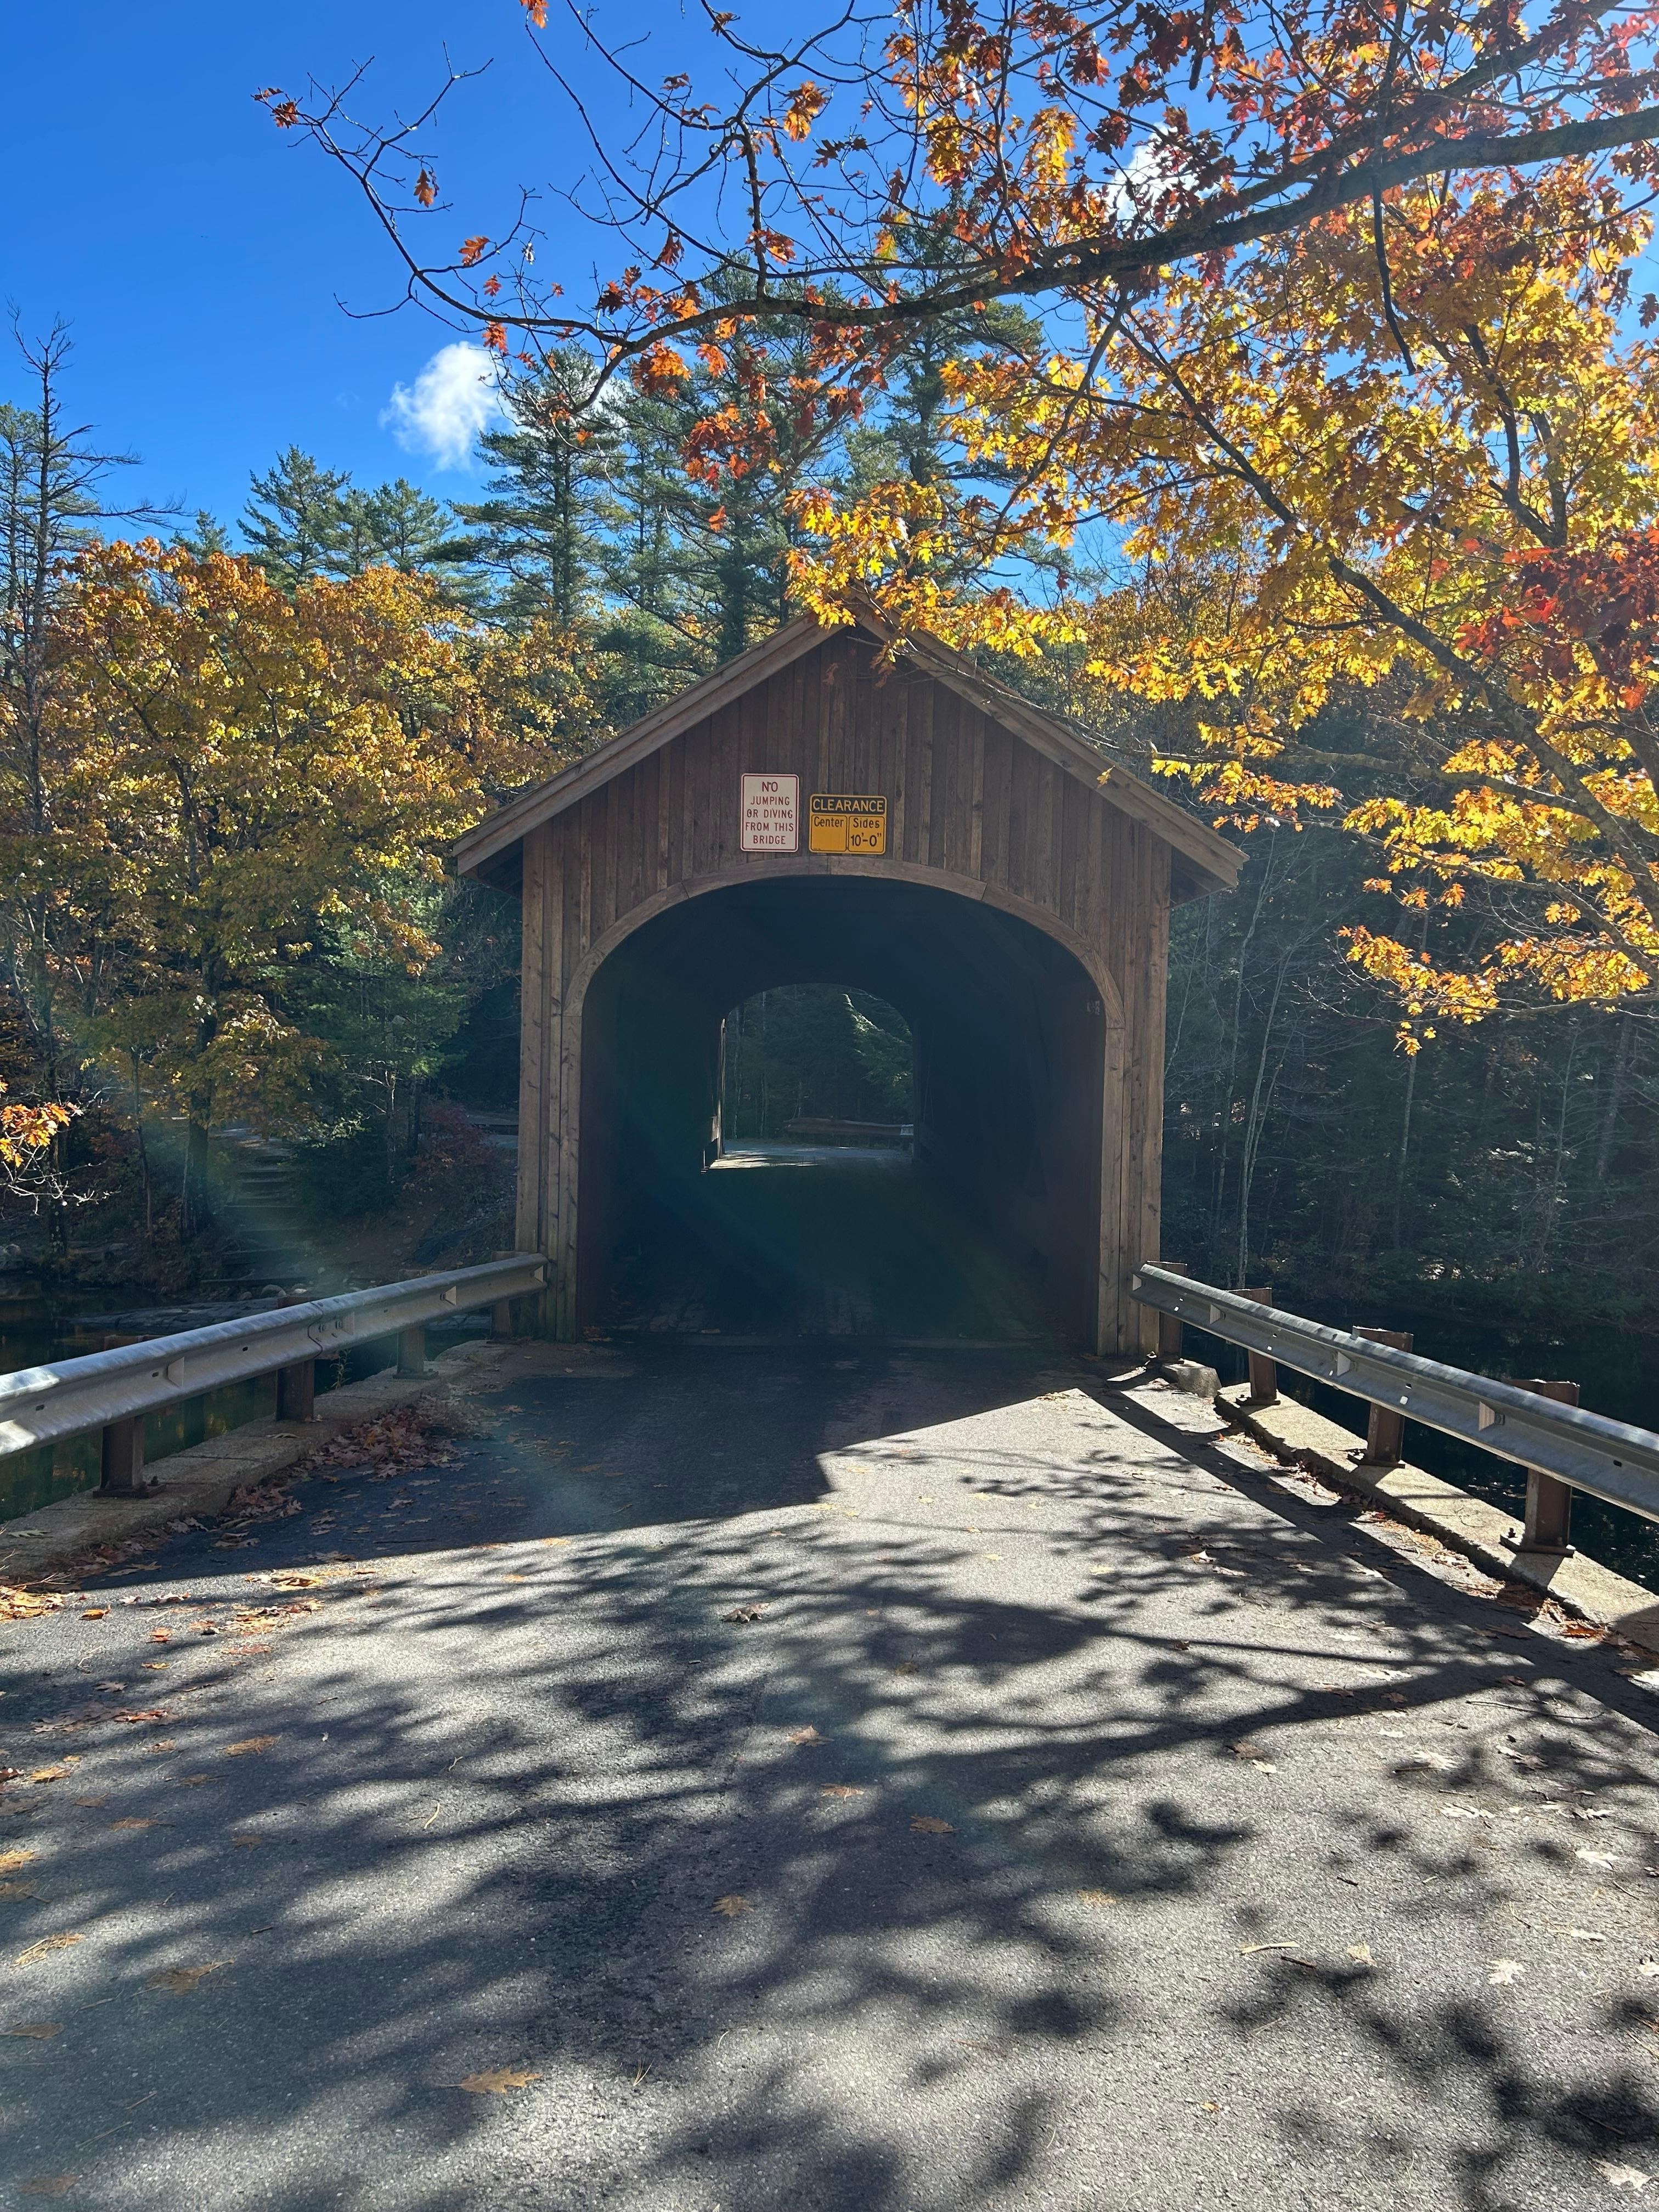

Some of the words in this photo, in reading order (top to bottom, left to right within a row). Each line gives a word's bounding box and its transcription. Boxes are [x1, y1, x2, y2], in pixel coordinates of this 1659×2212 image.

[762, 781, 778, 792] NO
[751, 796, 790, 805] JUMPING
[813, 798, 884, 812] CLEARANCE
[747, 809, 758, 818] OR
[764, 809, 793, 819] DIVING
[745, 822, 769, 831] FROM
[775, 822, 794, 832] THIS
[814, 816, 844, 828] Center
[853, 817, 880, 828] Sides
[753, 835, 786, 844] BRIDGE
